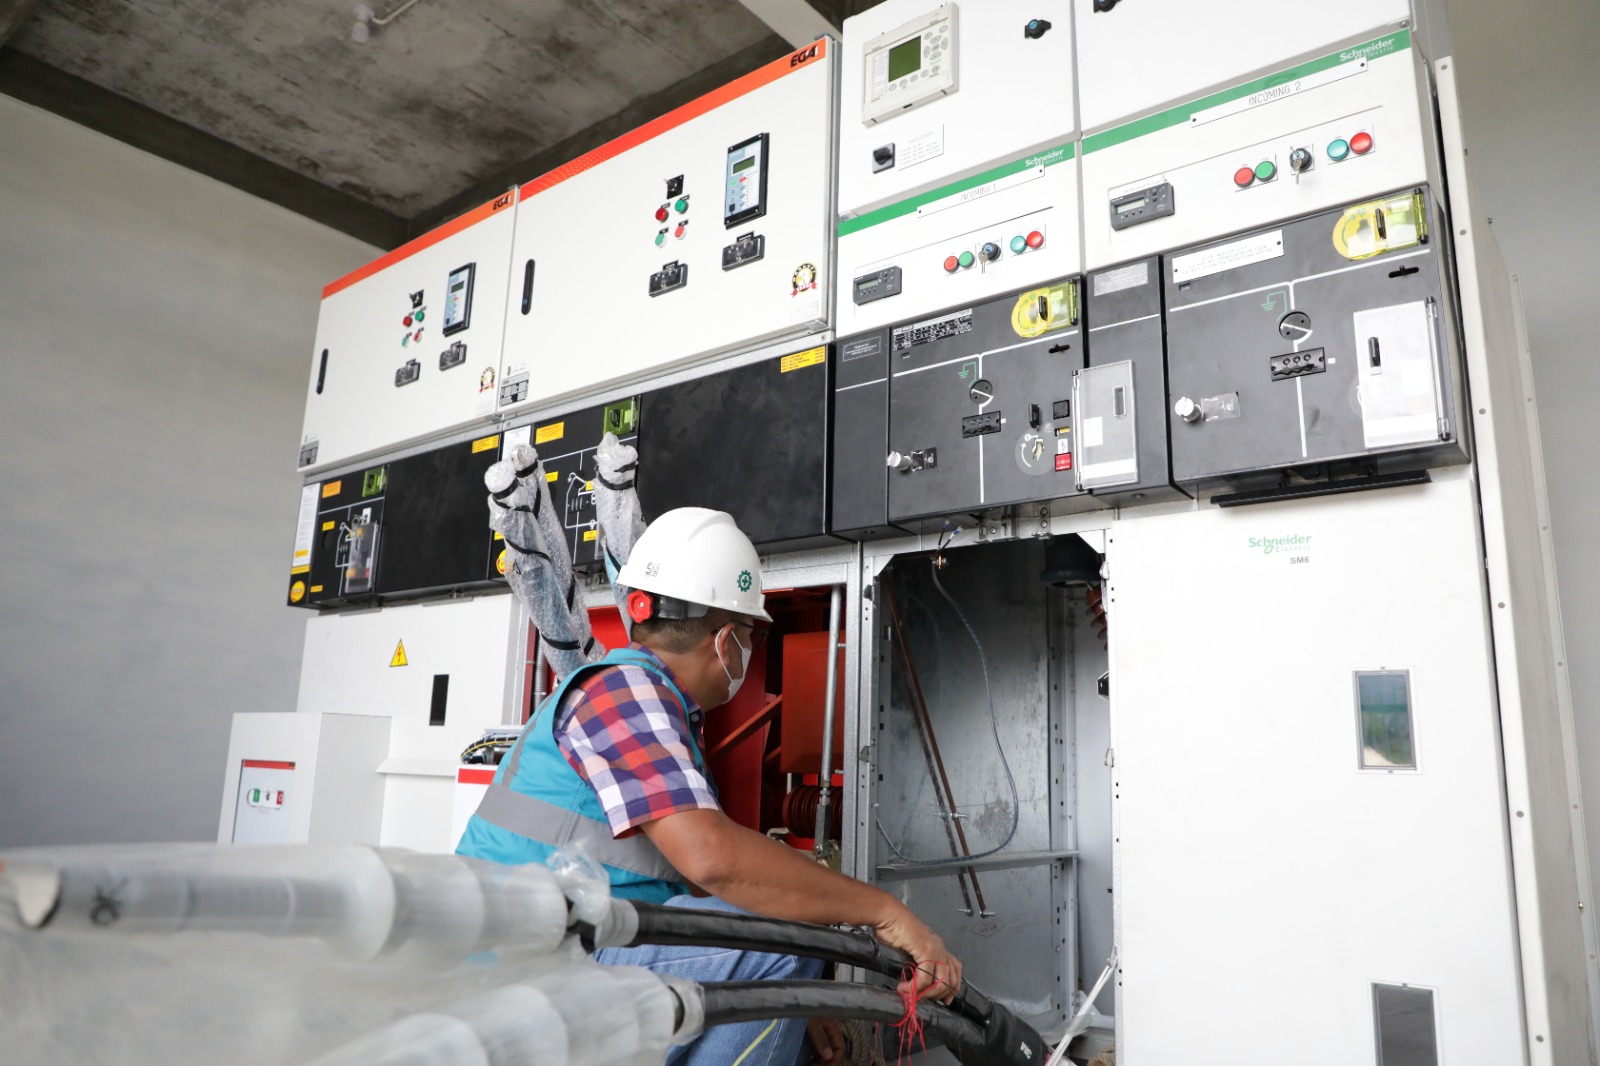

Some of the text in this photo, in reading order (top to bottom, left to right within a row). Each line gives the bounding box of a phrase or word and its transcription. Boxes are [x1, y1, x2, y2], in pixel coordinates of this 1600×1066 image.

[1340, 38, 1394, 61] Schneider
[1249, 81, 1302, 105] INCOMING 2
[1025, 149, 1064, 167] Schneider
[961, 185, 990, 201] INCOMING
[1248, 534, 1312, 548] Schneider
[1275, 545, 1312, 553] Electric
[1290, 556, 1310, 565] SM6
